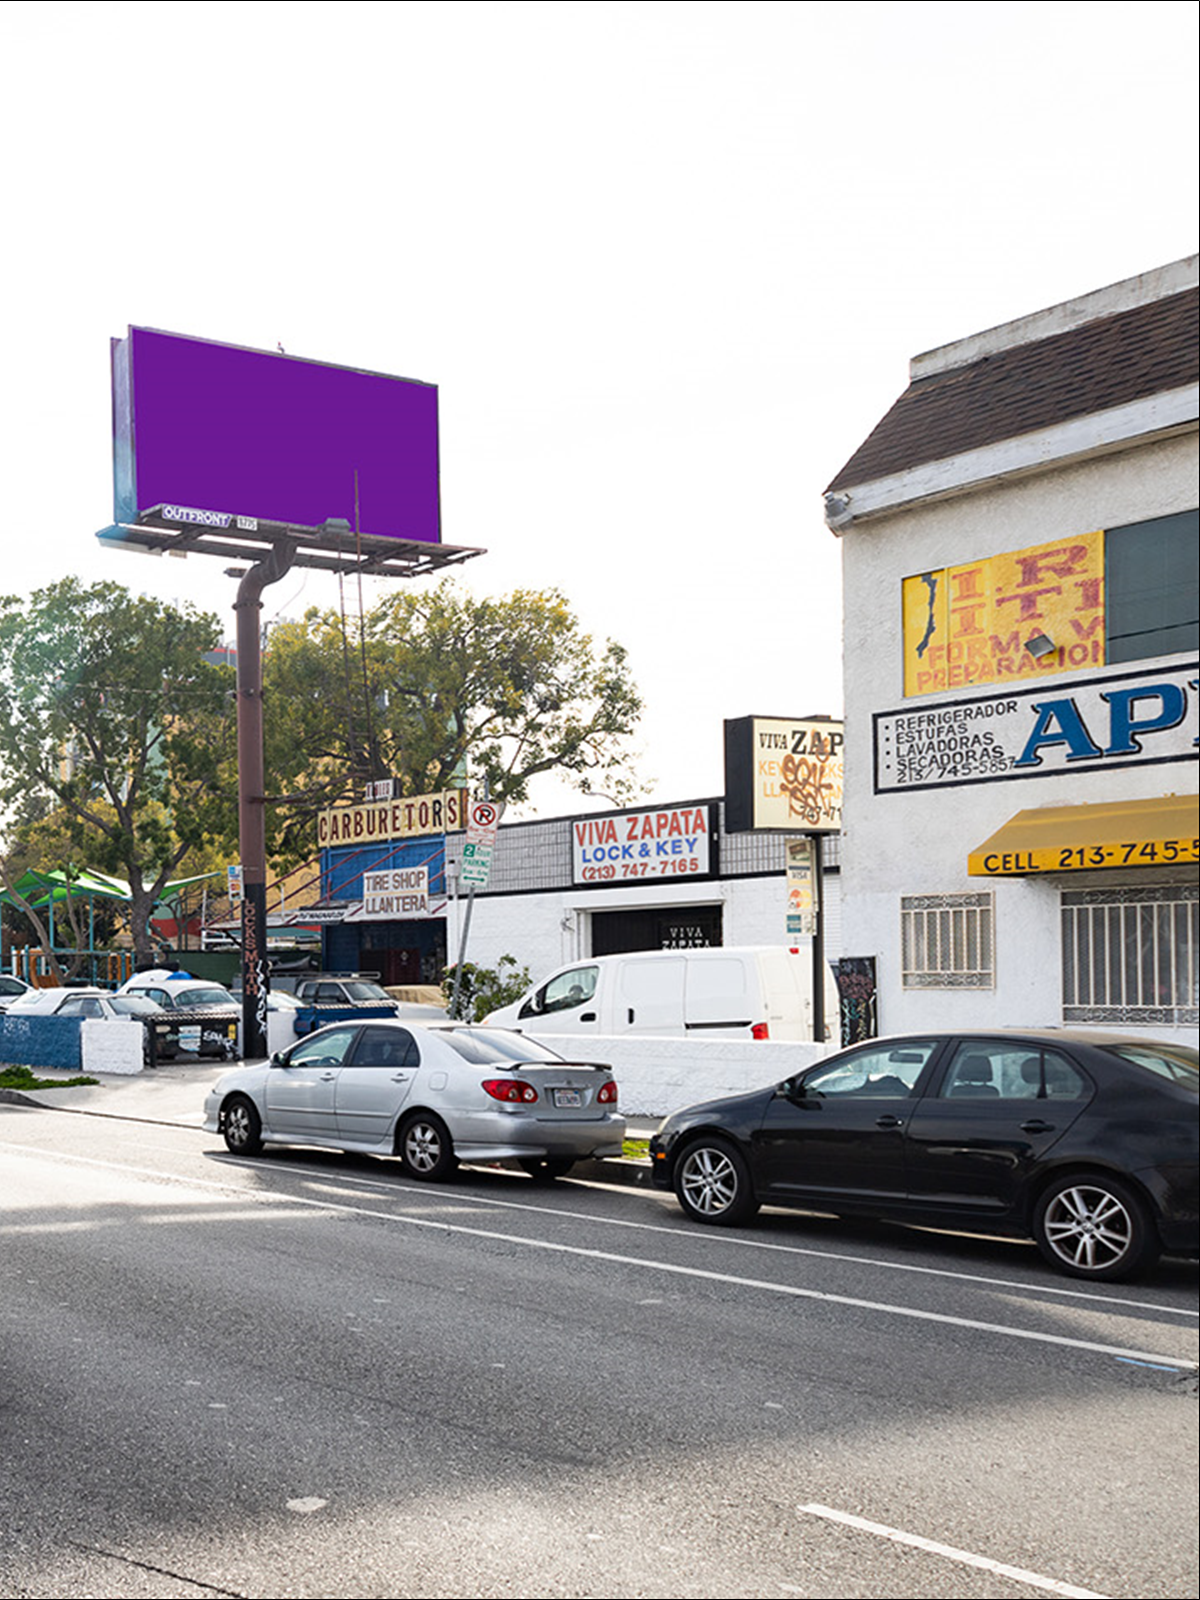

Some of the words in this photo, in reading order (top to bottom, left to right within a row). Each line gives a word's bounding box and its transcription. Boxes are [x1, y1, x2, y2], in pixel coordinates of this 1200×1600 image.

[162, 505, 231, 527] OUTFRONT
[895, 700, 1018, 732] REFRIGERADOR
[1012, 677, 1199, 770] AP
[759, 732, 788, 750] VIVA
[895, 722, 968, 744] ESTUFAS
[896, 731, 994, 758] LAVADORAS
[896, 745, 1004, 772] SECADORAS
[319, 796, 458, 842] CARBURETORS
[575, 819, 618, 847] VIVA
[626, 808, 706, 841] ZAPATA
[582, 844, 634, 863] LOCK
[638, 842, 650, 858] &
[656, 837, 698, 856] KEY
[582, 864, 616, 880] (213)
[983, 853, 1040, 873] CELL
[365, 874, 389, 892] TIRE
[392, 870, 426, 890] SHOP
[365, 894, 427, 914] LLANTERA
[670, 927, 702, 938] VIVA
